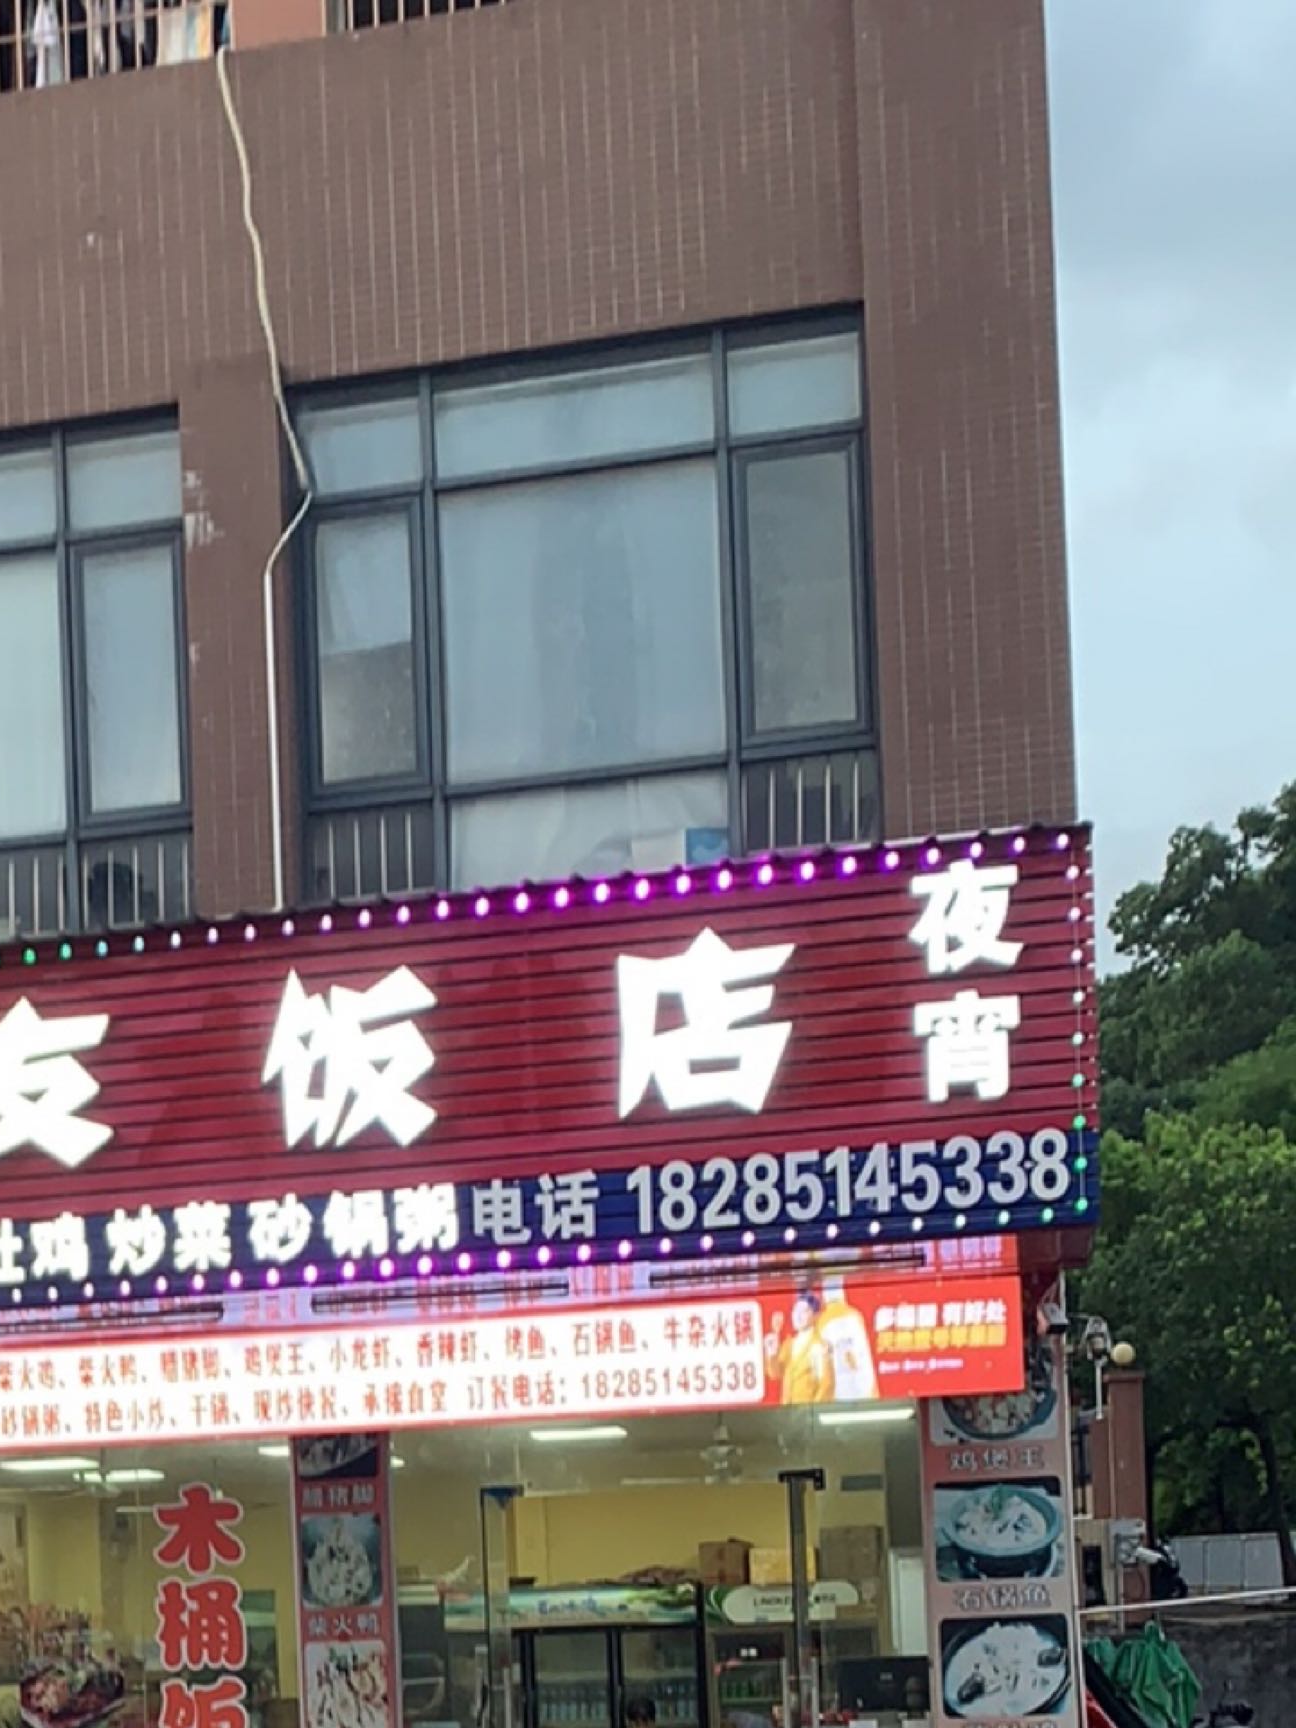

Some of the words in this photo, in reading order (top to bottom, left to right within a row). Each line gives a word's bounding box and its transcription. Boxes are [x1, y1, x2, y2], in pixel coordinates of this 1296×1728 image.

[909, 859, 1023, 1102] 夜宵
[473, 1170, 599, 1247] 电话
[626, 1128, 1069, 1234] 18285145338
